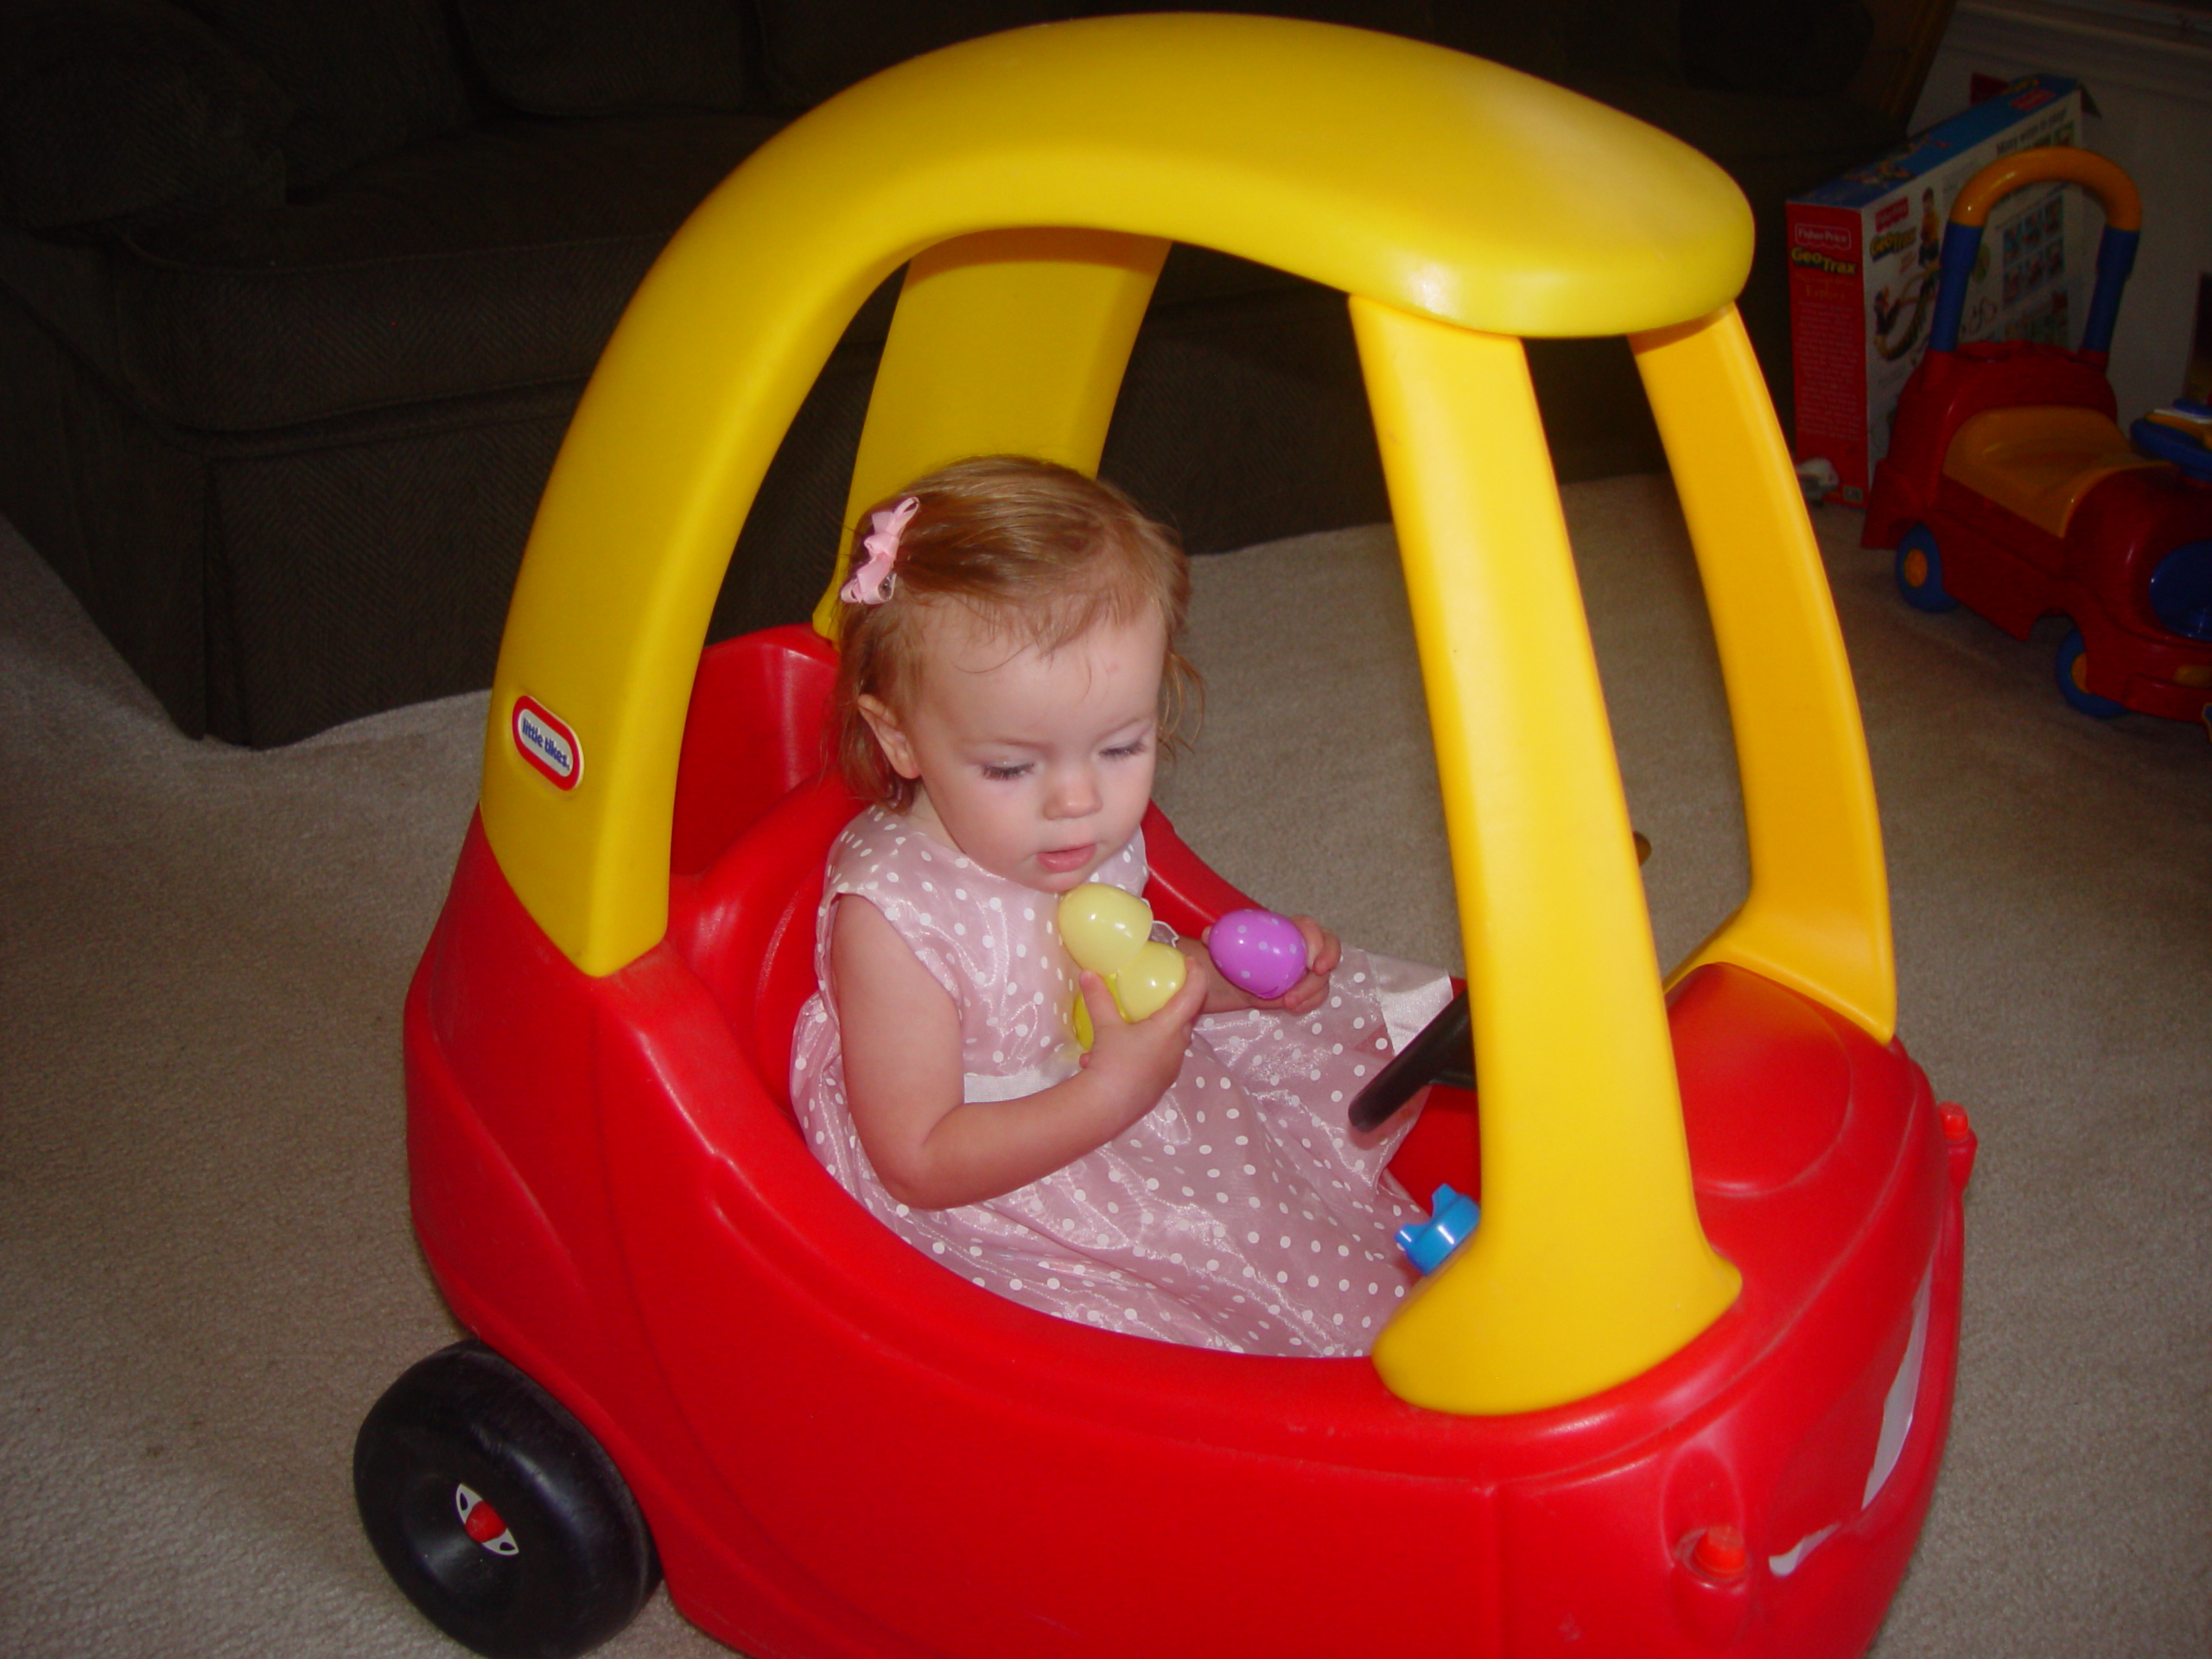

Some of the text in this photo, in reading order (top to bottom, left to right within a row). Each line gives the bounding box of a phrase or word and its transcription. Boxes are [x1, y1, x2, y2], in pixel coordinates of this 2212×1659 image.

[1798, 227, 1847, 244] Fisher-Price
[1790, 246, 1857, 276] GeoTrax
[522, 716, 568, 768] little tikes
